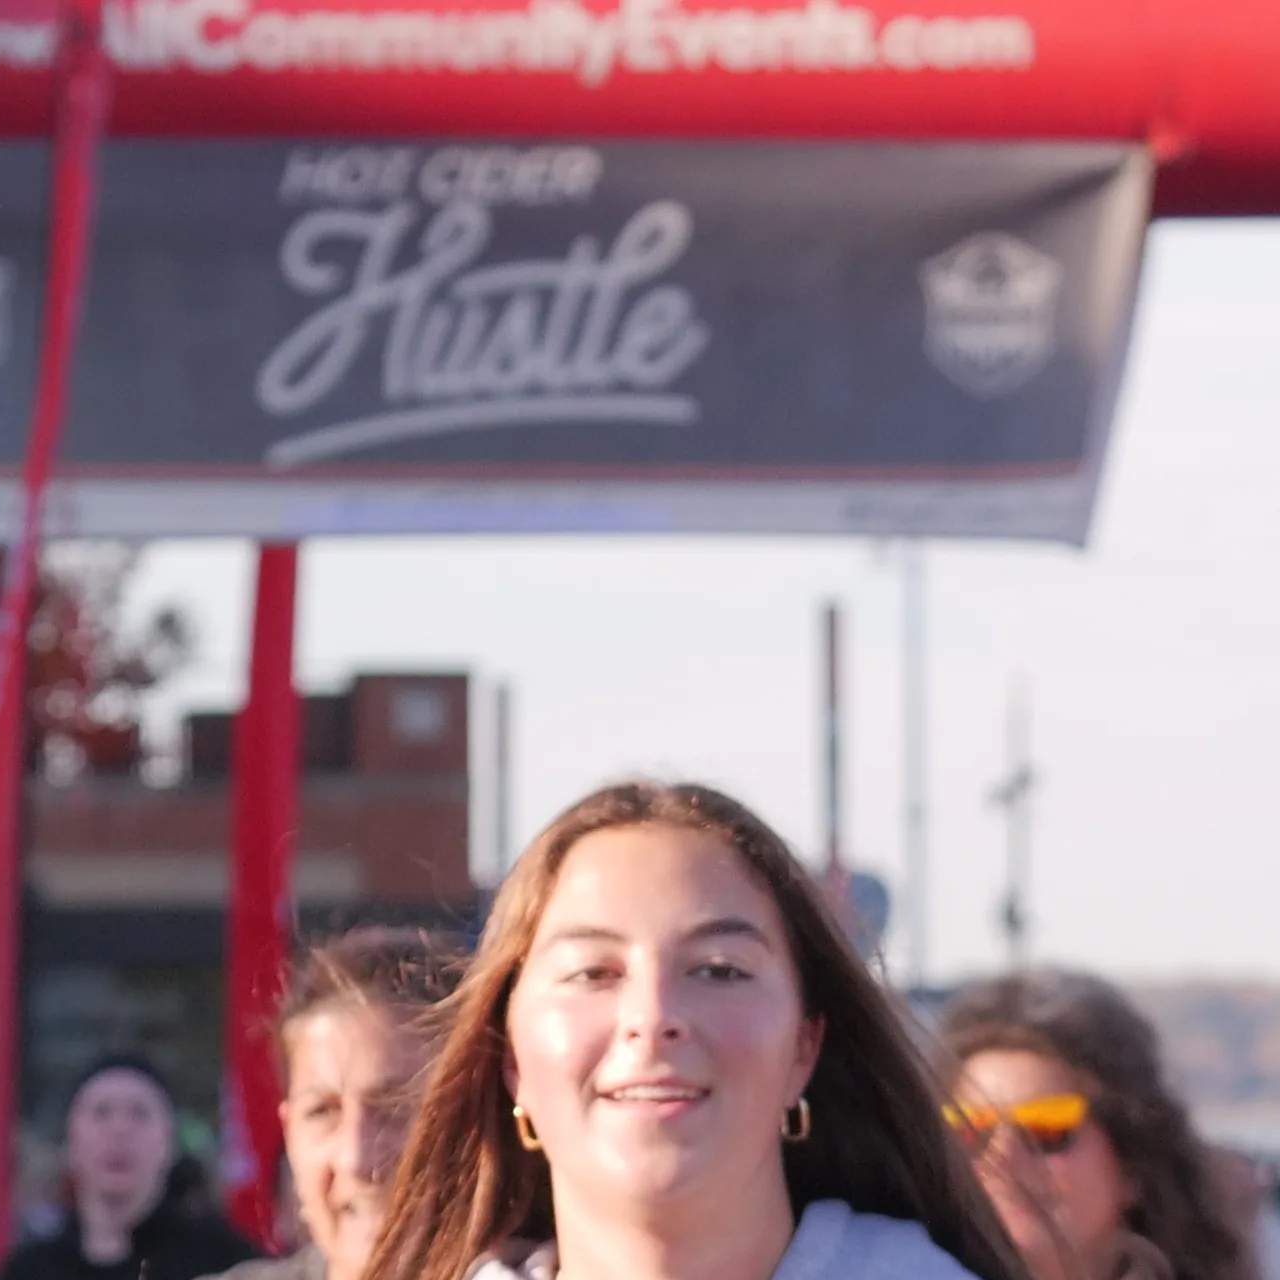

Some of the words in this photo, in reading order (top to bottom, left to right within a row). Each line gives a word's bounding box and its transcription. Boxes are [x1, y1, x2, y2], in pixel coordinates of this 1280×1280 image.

[280, 146, 415, 202] HOT
[421, 145, 604, 202] CIDER
[256, 199, 710, 412] Hustle
